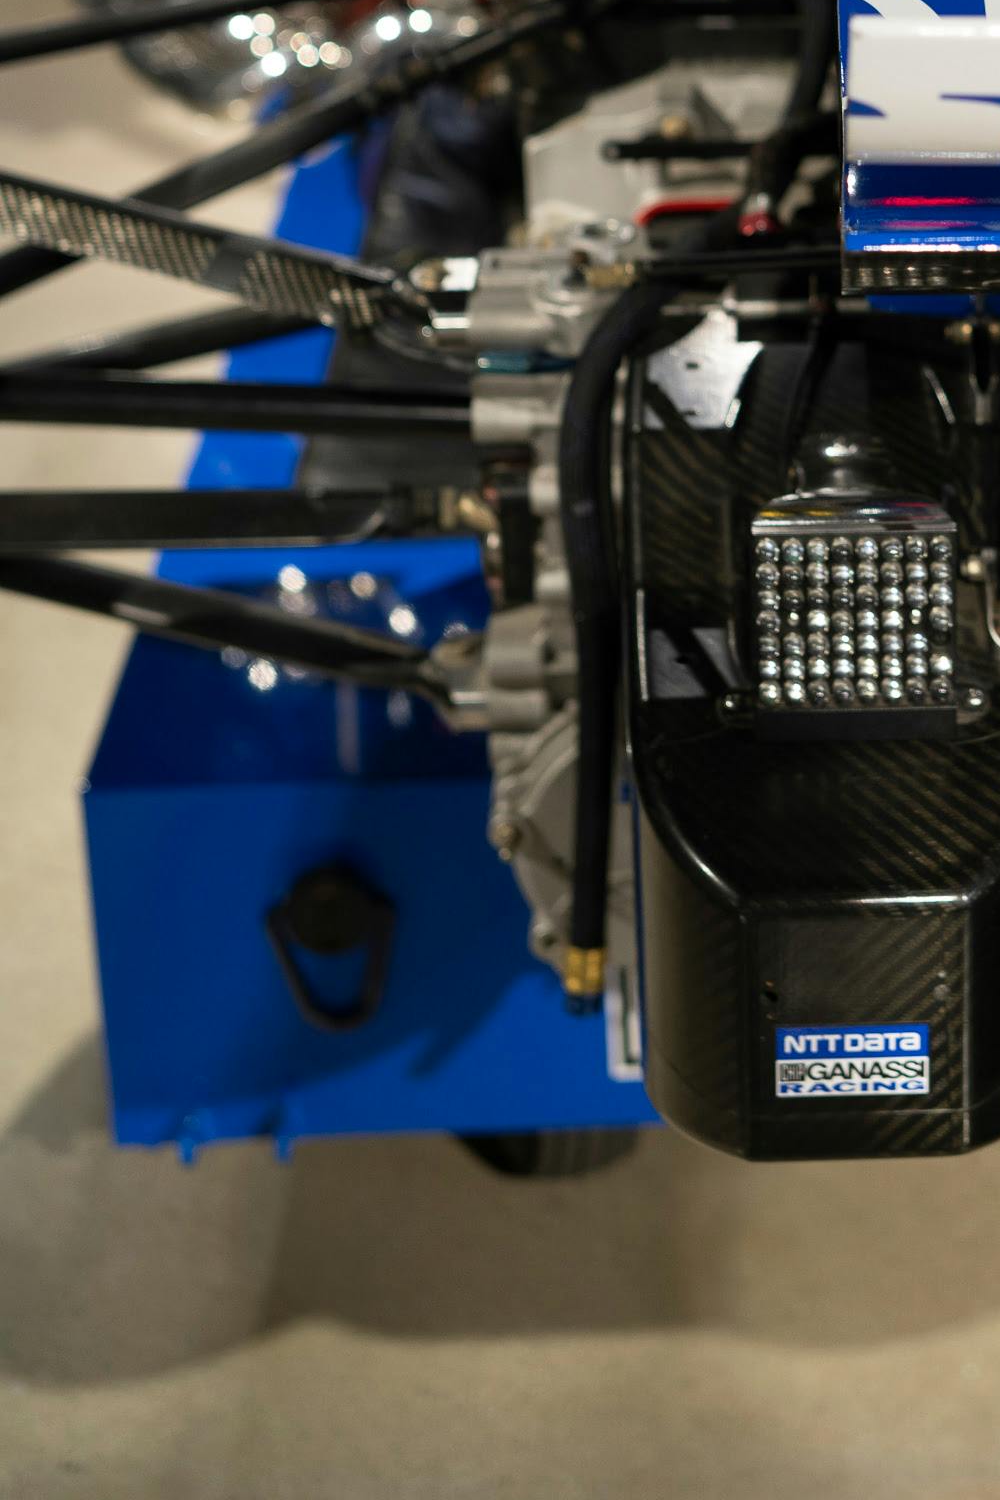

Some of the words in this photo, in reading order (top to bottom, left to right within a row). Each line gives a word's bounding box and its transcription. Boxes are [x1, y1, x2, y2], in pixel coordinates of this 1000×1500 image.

[783, 1033, 842, 1054] NTT
[807, 1060, 924, 1081] GANASSI
[779, 1080, 925, 1094] RACING
